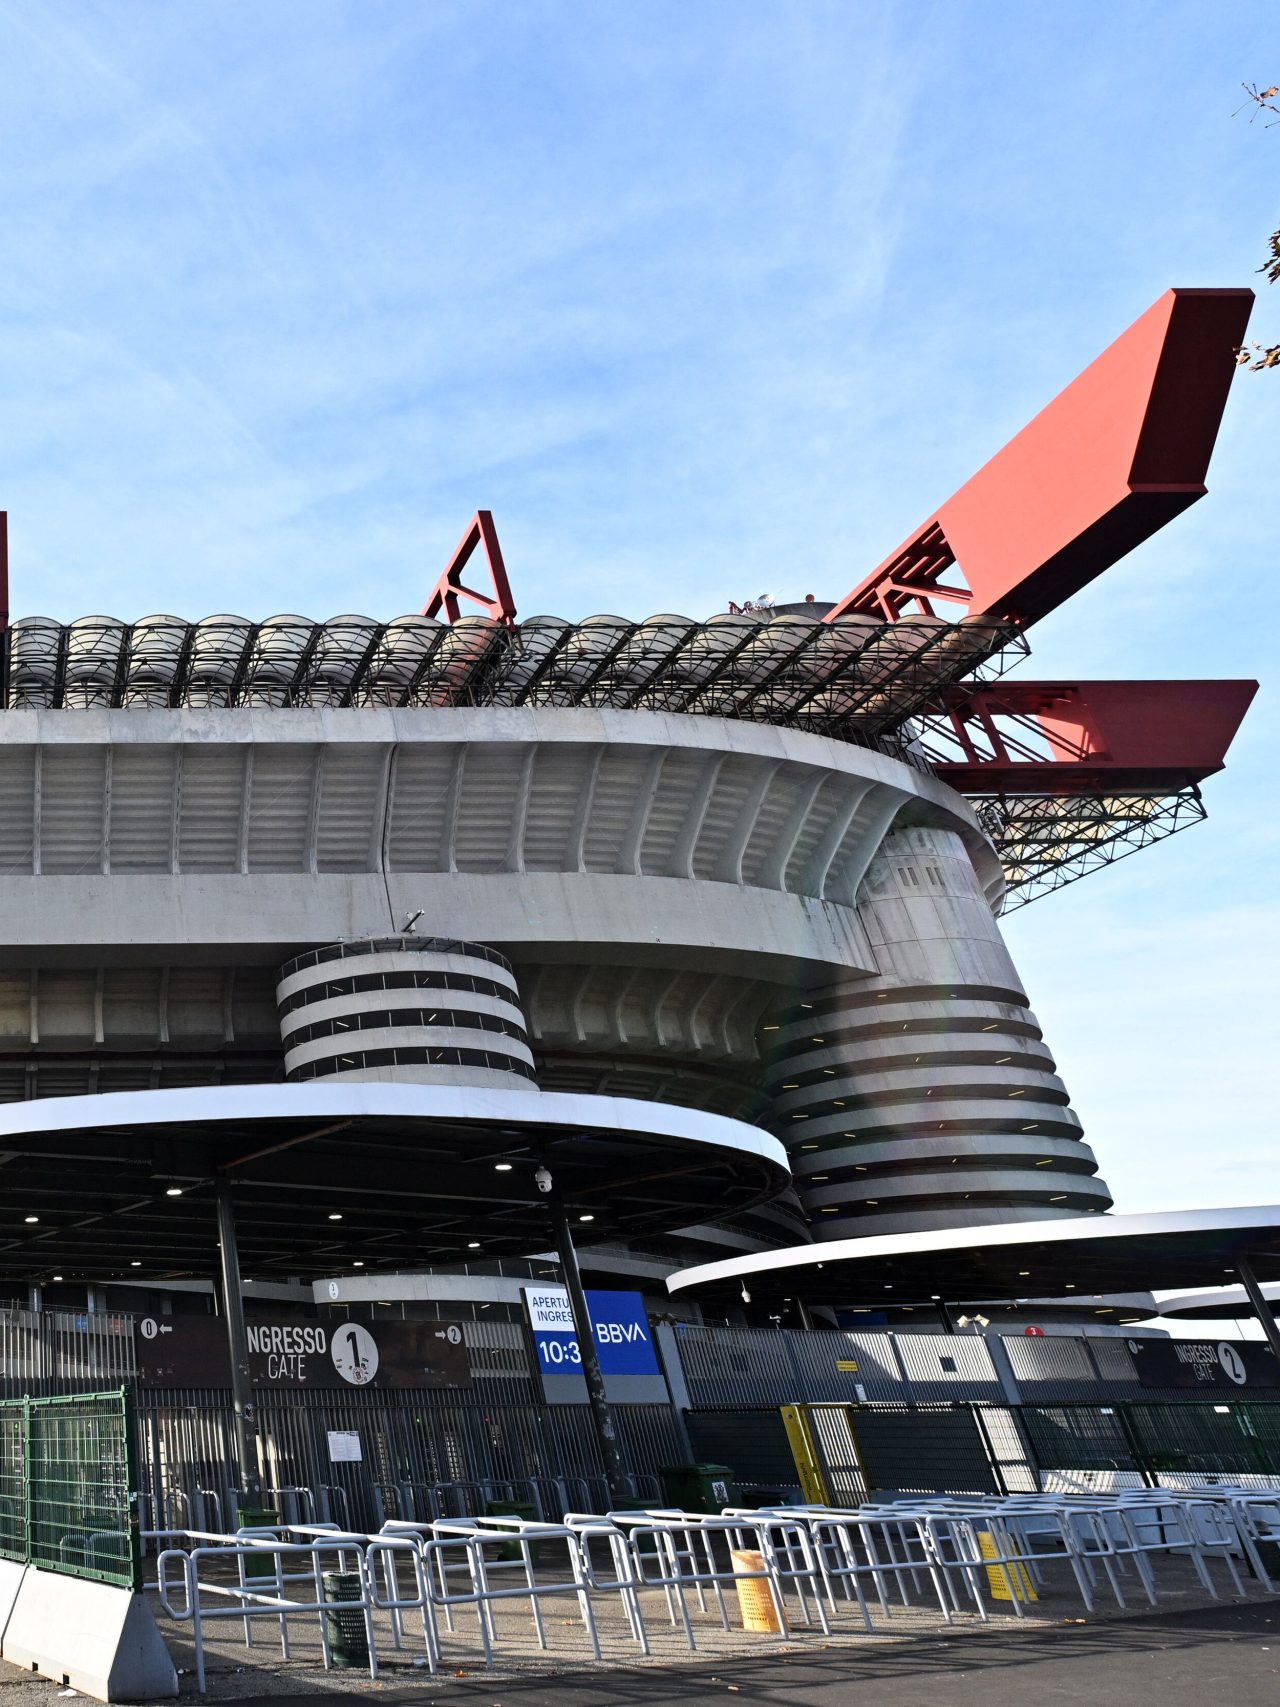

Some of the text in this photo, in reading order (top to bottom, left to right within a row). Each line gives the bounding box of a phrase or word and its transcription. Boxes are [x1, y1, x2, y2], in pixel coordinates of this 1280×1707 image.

[532, 1297, 569, 1309] APERTU
[537, 1310, 573, 1322] INGRES
[246, 1326, 326, 1354] NGRESSO
[451, 1328, 458, 1342] 2
[596, 1322, 647, 1343] BBVA
[346, 1331, 361, 1368] 1
[540, 1341, 582, 1364] 10:3
[1174, 1344, 1218, 1363] INGRESSO
[268, 1354, 307, 1379] GATE
[1193, 1364, 1216, 1381] GATE
[1224, 1347, 1242, 1379] 2
